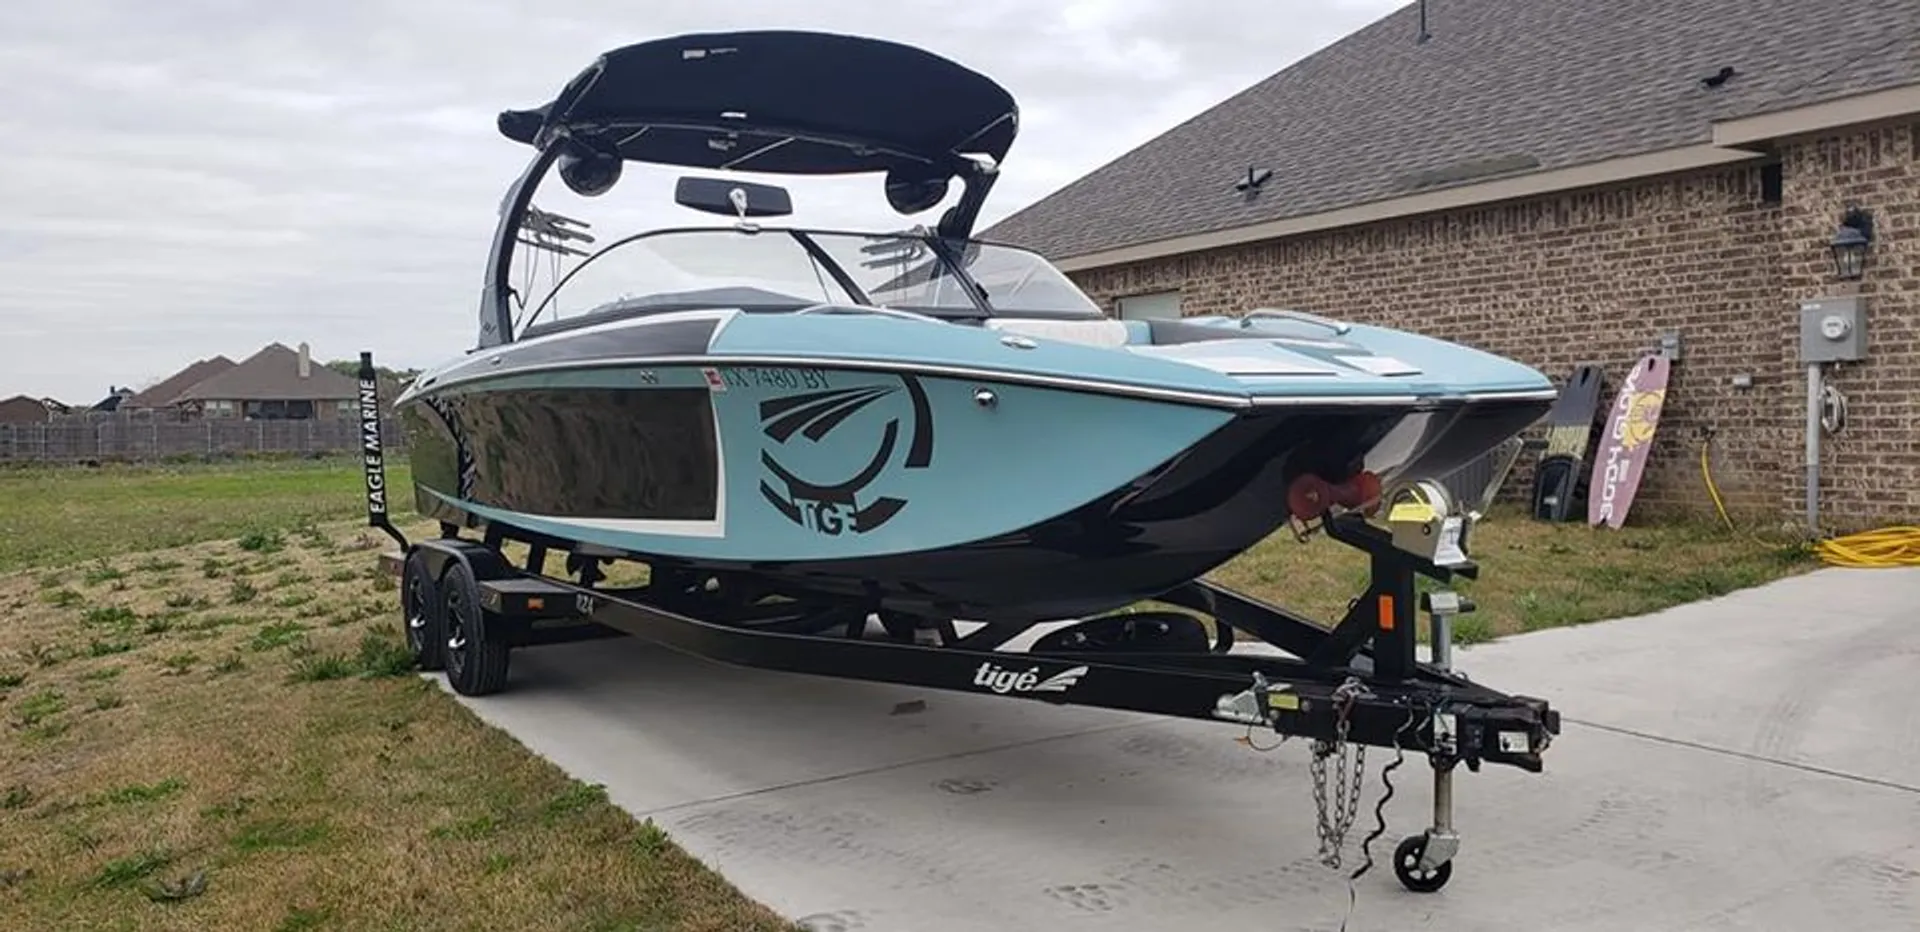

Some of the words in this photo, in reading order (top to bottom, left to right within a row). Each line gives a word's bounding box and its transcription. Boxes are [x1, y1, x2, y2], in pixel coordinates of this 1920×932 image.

[723, 367, 749, 387] TX
[748, 367, 799, 388] 7480
[801, 366, 829, 389] BY
[360, 379, 380, 450] MARINE
[366, 455, 386, 513] EAGLE
[973, 662, 1040, 693] tigé
